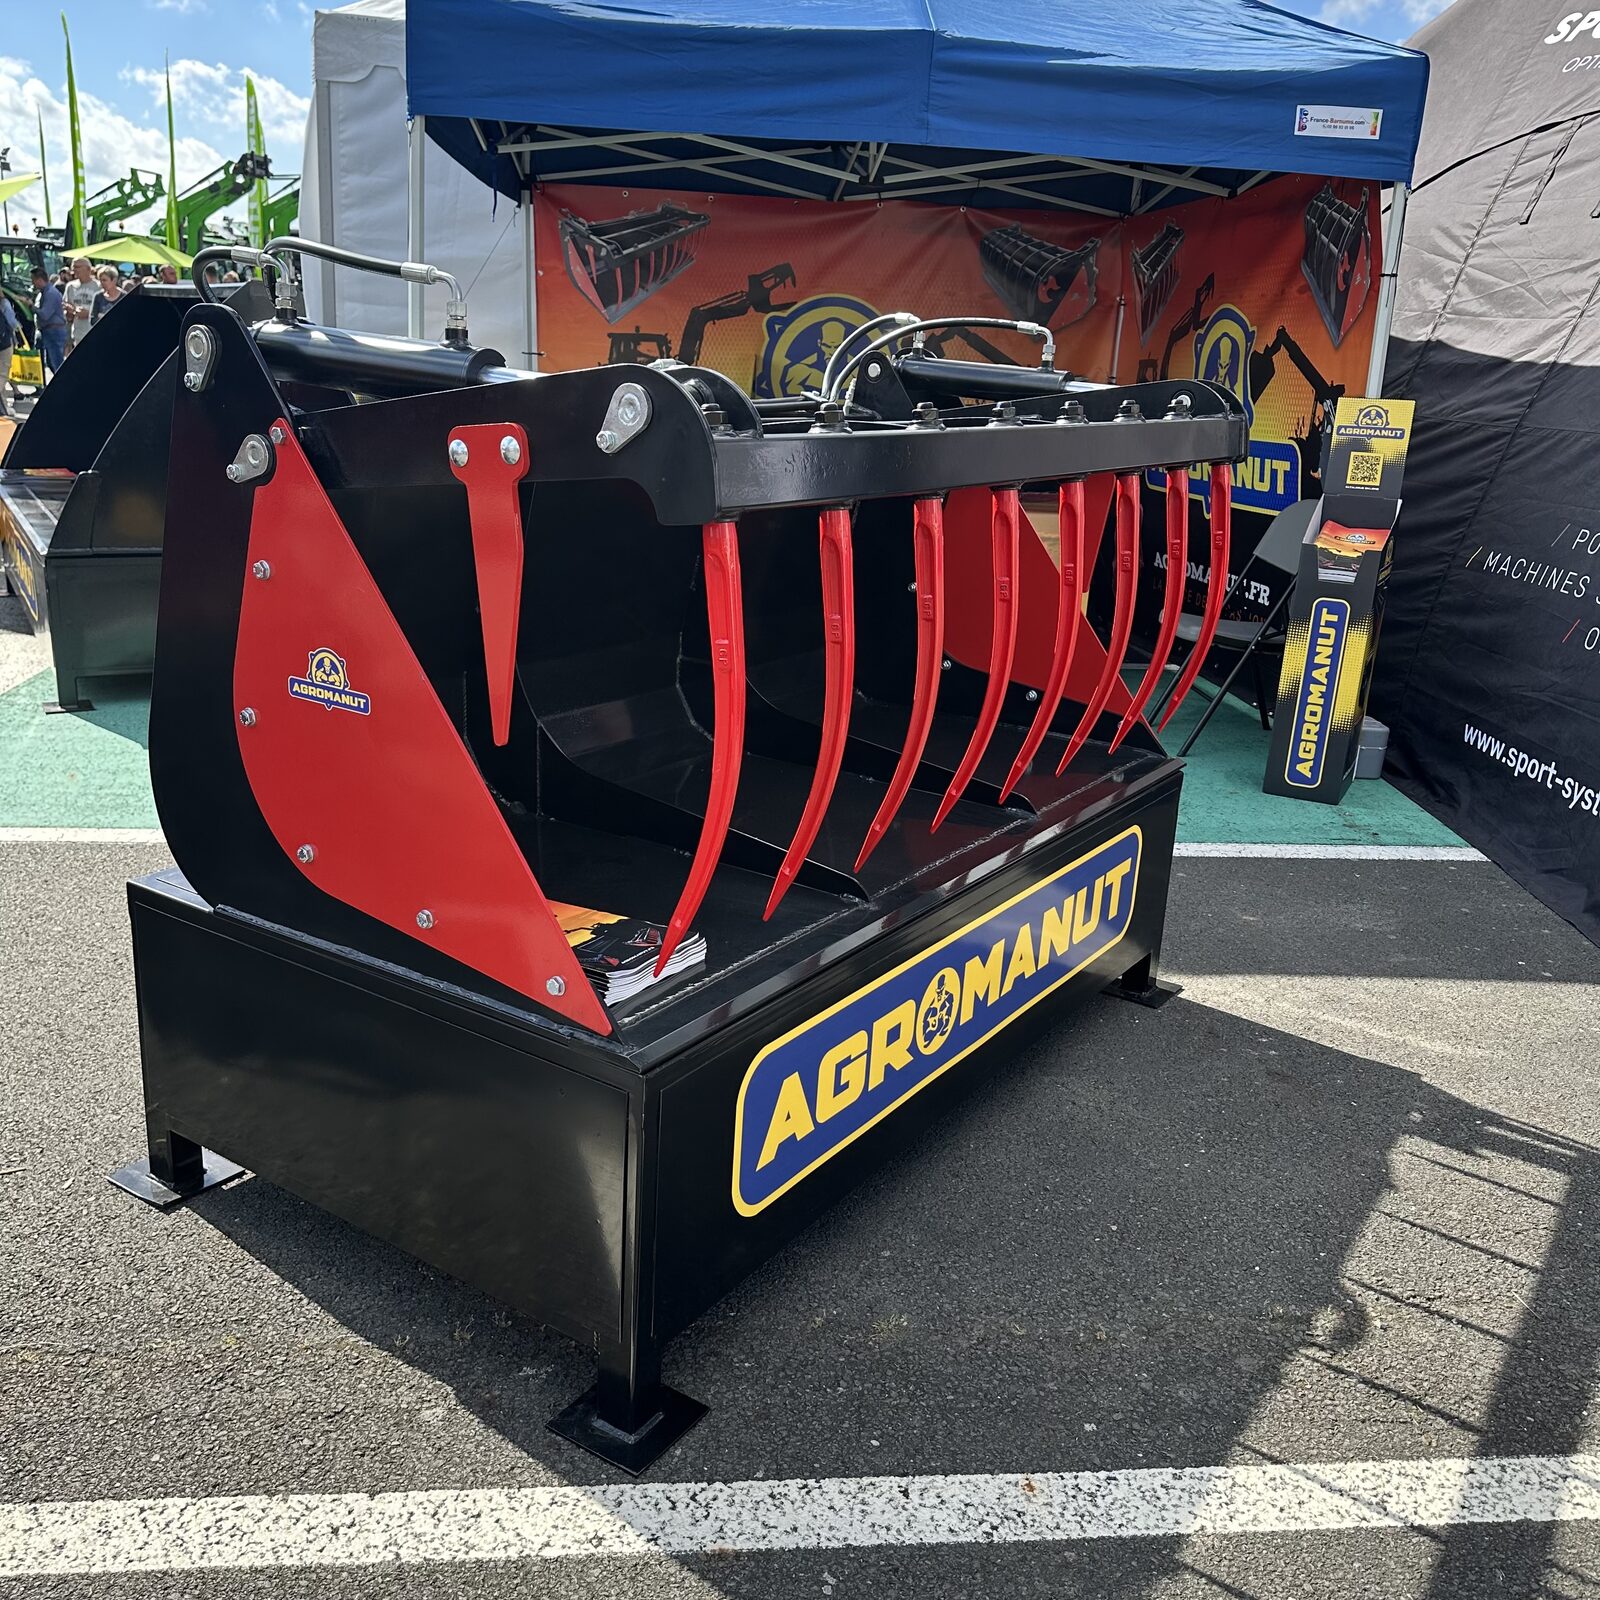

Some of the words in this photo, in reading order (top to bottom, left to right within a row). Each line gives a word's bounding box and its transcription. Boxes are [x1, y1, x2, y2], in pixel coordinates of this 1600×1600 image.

[1338, 426, 1403, 438] AGROMANUT
[1483, 551, 1591, 598] MACHINES
[292, 682, 367, 709] AGROMANUT
[1295, 607, 1339, 779] AGROMANUT
[1463, 723, 1600, 818] www.sport-syst
[755, 857, 1132, 1172] AGROMANUT
